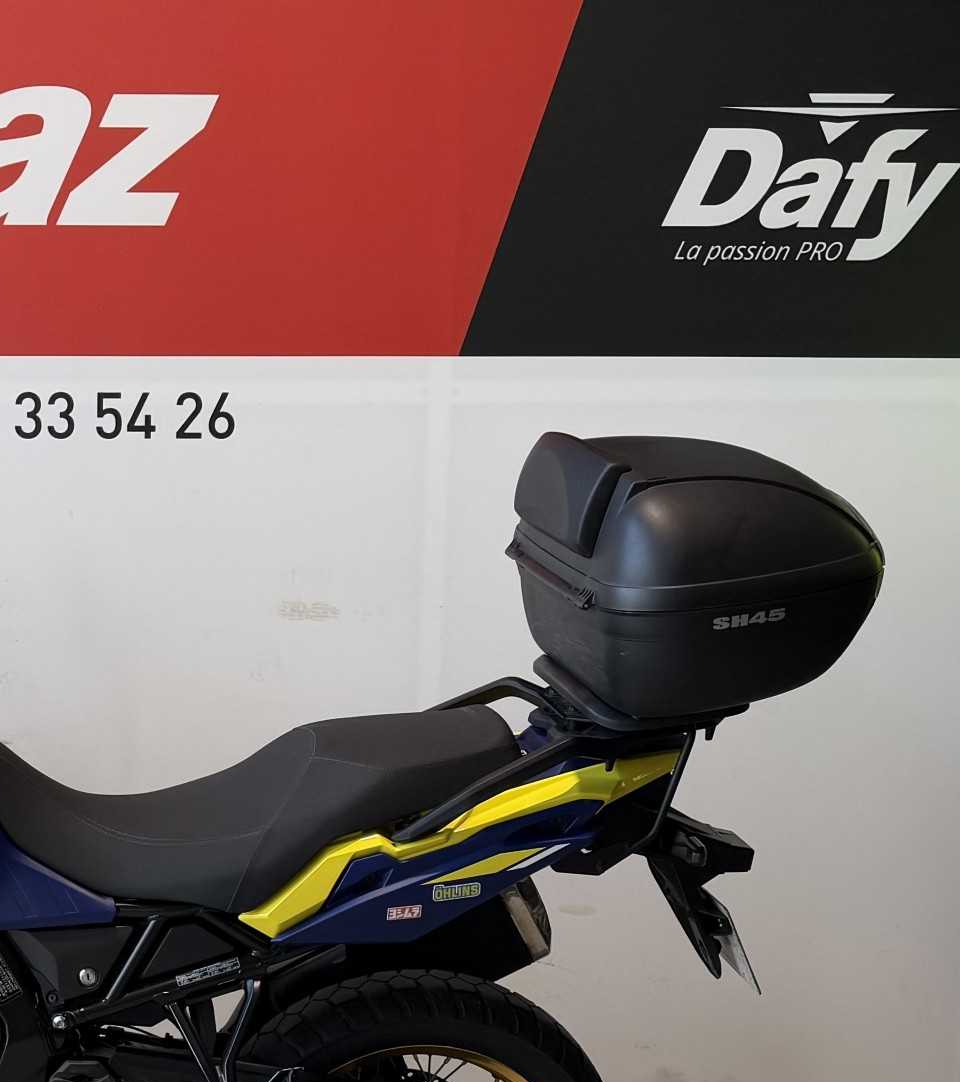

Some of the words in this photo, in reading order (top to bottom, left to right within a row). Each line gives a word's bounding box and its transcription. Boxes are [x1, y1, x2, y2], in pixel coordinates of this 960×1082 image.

[661, 127, 960, 261] Dafy
[673, 240, 702, 261] La
[702, 240, 791, 266] passion
[795, 241, 844, 262] PRO
[14, 391, 75, 440] 33
[95, 391, 156, 440] 54
[175, 391, 235, 440] 26
[712, 608, 786, 630] SH45
[434, 884, 480, 900] ÖHLINS
